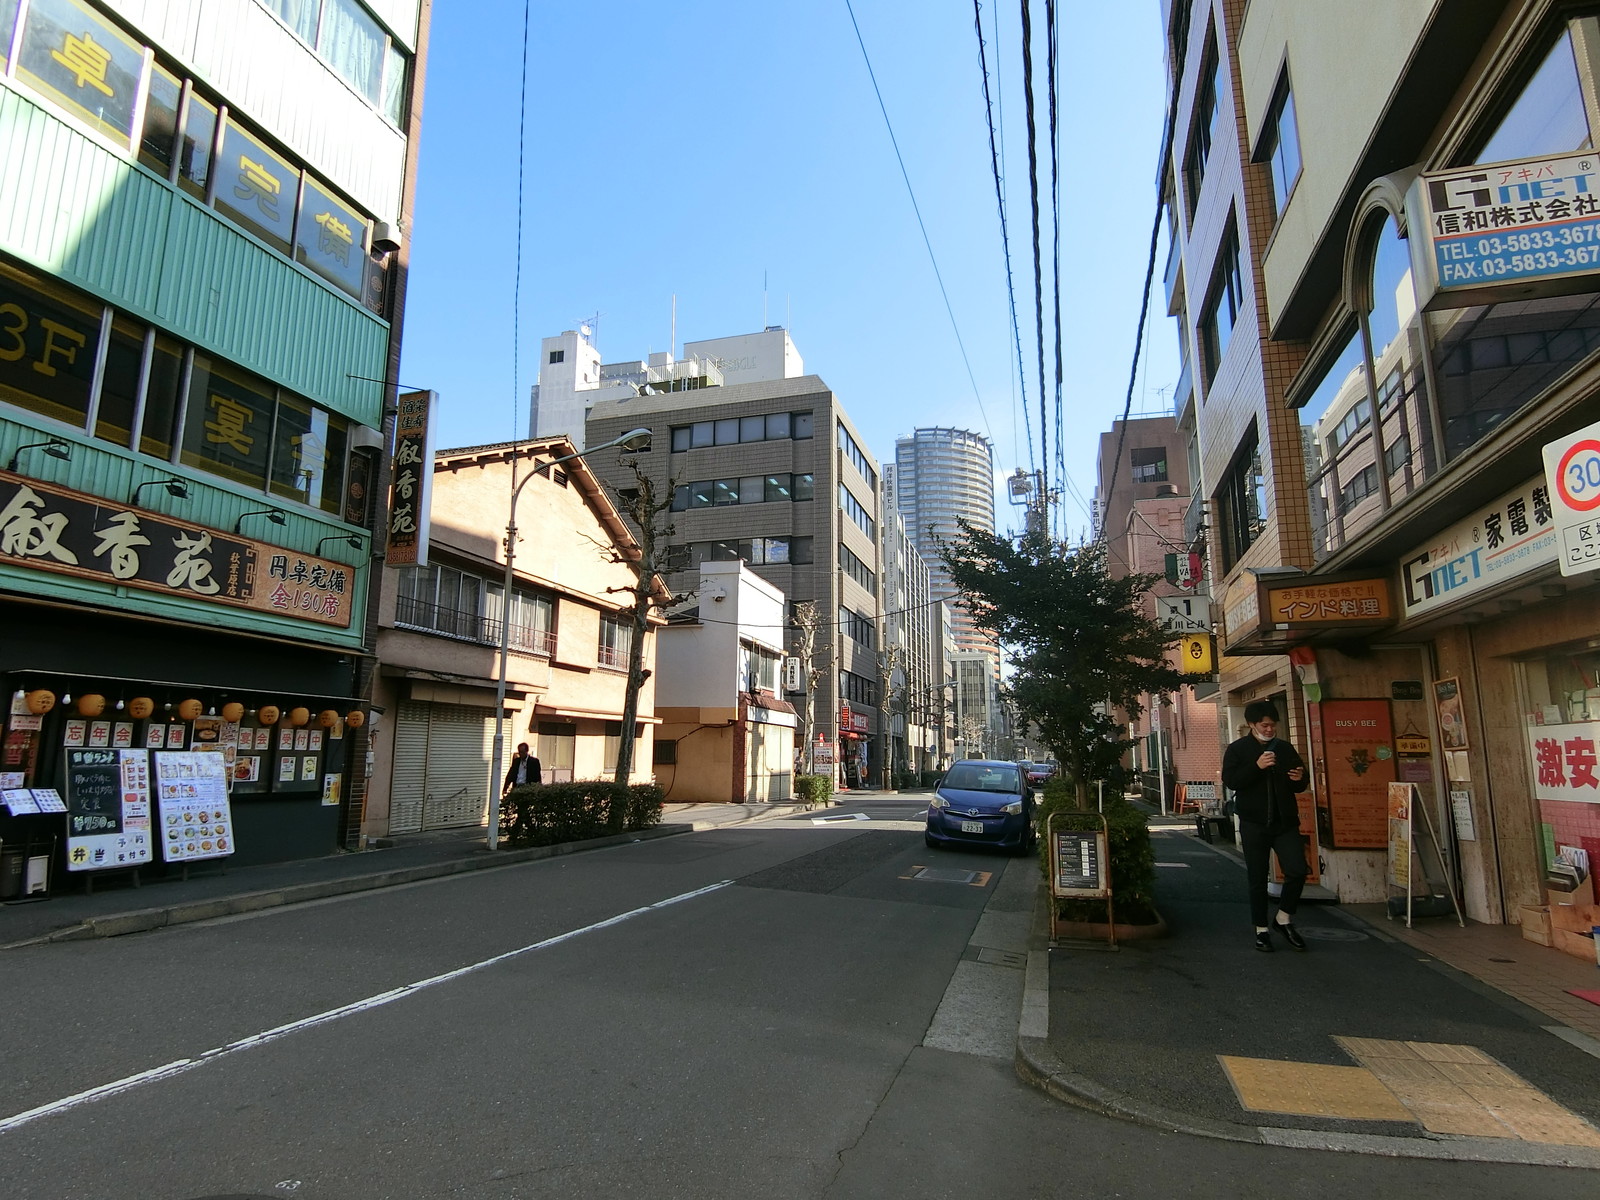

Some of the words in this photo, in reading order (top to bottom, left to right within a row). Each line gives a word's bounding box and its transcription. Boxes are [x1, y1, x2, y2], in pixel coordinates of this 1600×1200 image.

[51, 33, 115, 98] 卓
[1497, 164, 1555, 185] アキバ
[1436, 193, 1600, 234] 信和株式会社
[0, 303, 86, 377] 3F
[1568, 456, 1600, 494] 30
[1579, 521, 1600, 541] 区
[1430, 537, 1460, 568] アキバ
[1571, 544, 1600, 562] ここ
[227, 551, 241, 597] 秋葉原店
[269, 555, 346, 595] 円卓完備
[270, 582, 340, 618] 全130席
[1279, 597, 1381, 620] インド料理
[68, 725, 131, 744] 忘年会
[149, 727, 183, 745] 各種
[239, 732, 269, 745] 宴会
[281, 733, 321, 746] 受付中
[1534, 736, 1600, 790] 激安
